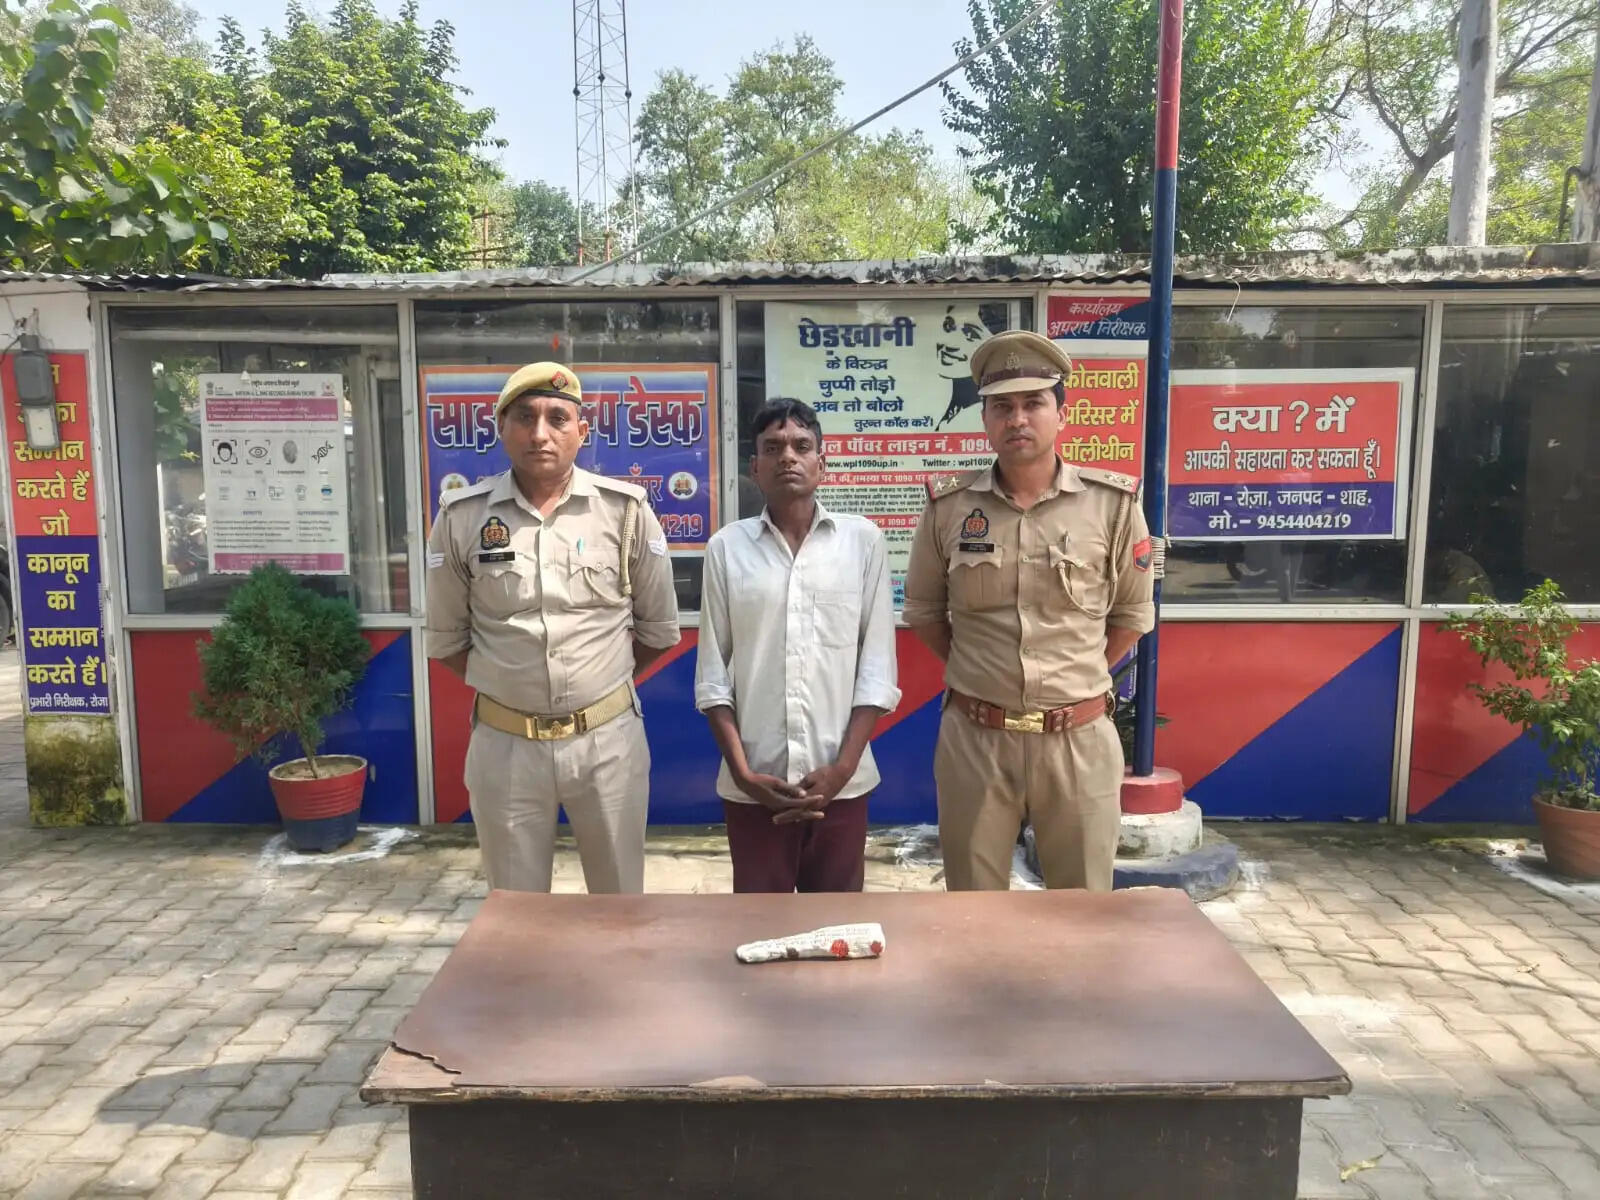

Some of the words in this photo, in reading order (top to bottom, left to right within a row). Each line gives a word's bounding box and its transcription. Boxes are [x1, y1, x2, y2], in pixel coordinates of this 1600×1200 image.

[1048, 320, 1094, 337] अपराध
[1097, 317, 1147, 337] निरीक्षक
[826, 356, 841, 370] के
[845, 355, 888, 371] विरुद्ध
[818, 375, 856, 397] चुप्पी
[860, 375, 896, 395] तोड़ो
[1063, 362, 1140, 390] कोतवाली
[623, 375, 706, 447] डेस्क
[812, 400, 838, 413] अब
[843, 397, 861, 413] तो
[866, 396, 904, 413] बोलो
[1120, 399, 1140, 426] में
[1211, 405, 1283, 433] क्या
[1288, 400, 1311, 433] ?
[1314, 394, 1357, 433] मैं
[853, 418, 881, 433] तुरन्त
[884, 416, 909, 428] कॉल
[846, 437, 883, 453] पॉवर
[887, 439, 930, 454] लाइन
[1061, 434, 1135, 463] पॉलीथीन
[1183, 440, 1231, 471] आपकी
[1234, 448, 1288, 472] सहायता
[1290, 448, 1314, 469] कर
[1317, 447, 1360, 469] सकता
[922, 458, 951, 468] Twitter
[16, 470, 67, 500] करते
[70, 469, 91, 501] हैं
[1188, 490, 1220, 507] थाना
[1277, 490, 1324, 506] जनपद
[1340, 489, 1373, 507] शाह.
[39, 508, 70, 536] जो
[1257, 513, 1352, 530] 9454404219
[26, 553, 90, 585] कानून
[45, 590, 76, 610] का
[28, 627, 99, 648] सम्मान
[26, 655, 77, 684] करते
[29, 692, 52, 709] प्रभारी
